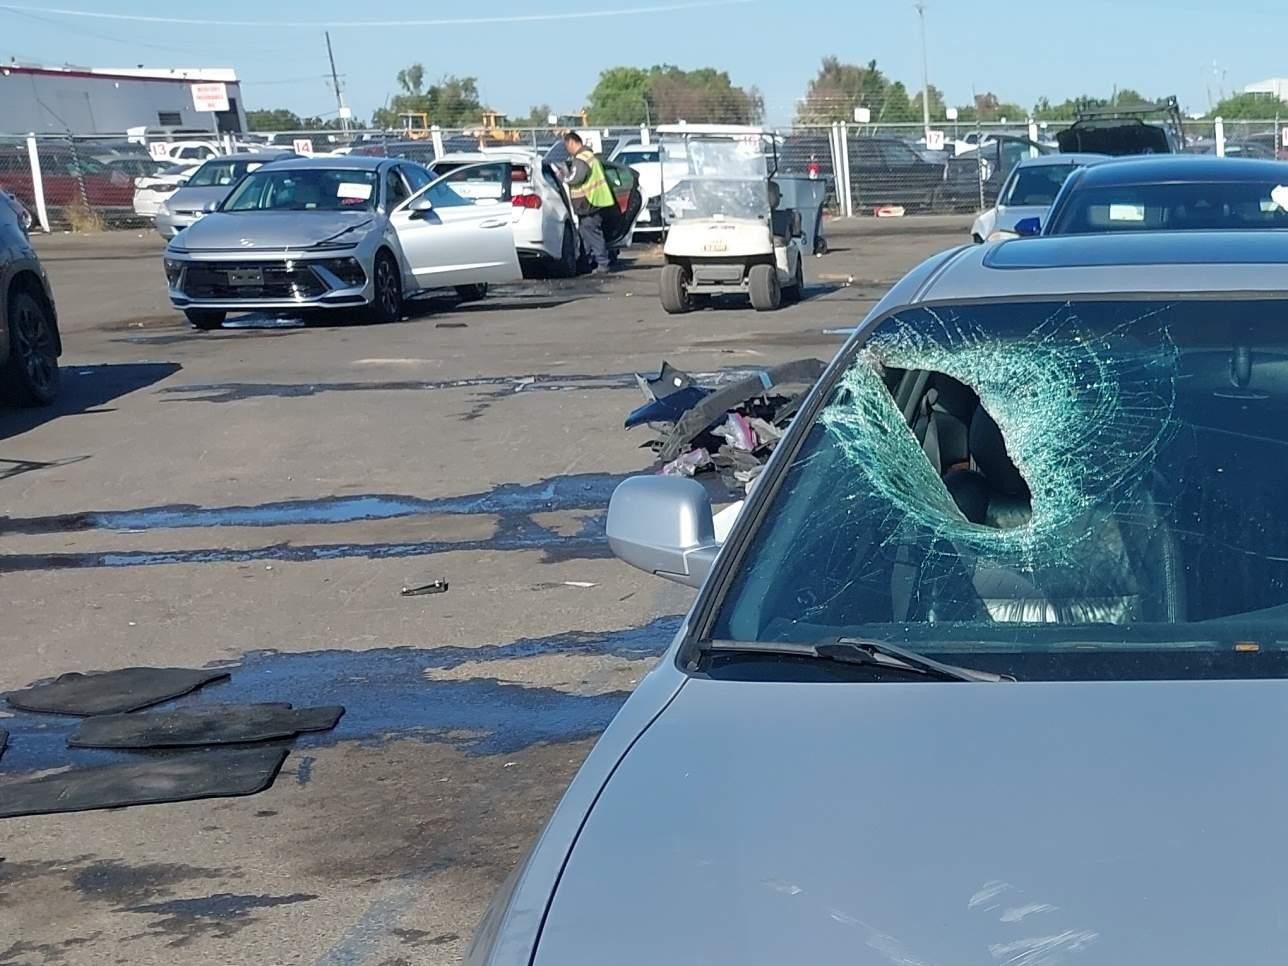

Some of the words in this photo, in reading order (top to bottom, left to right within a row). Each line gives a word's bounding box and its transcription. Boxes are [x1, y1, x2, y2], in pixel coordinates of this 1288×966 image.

[929, 133, 940, 145] 17
[153, 144, 166, 155] 13
[295, 142, 310, 153] 14
